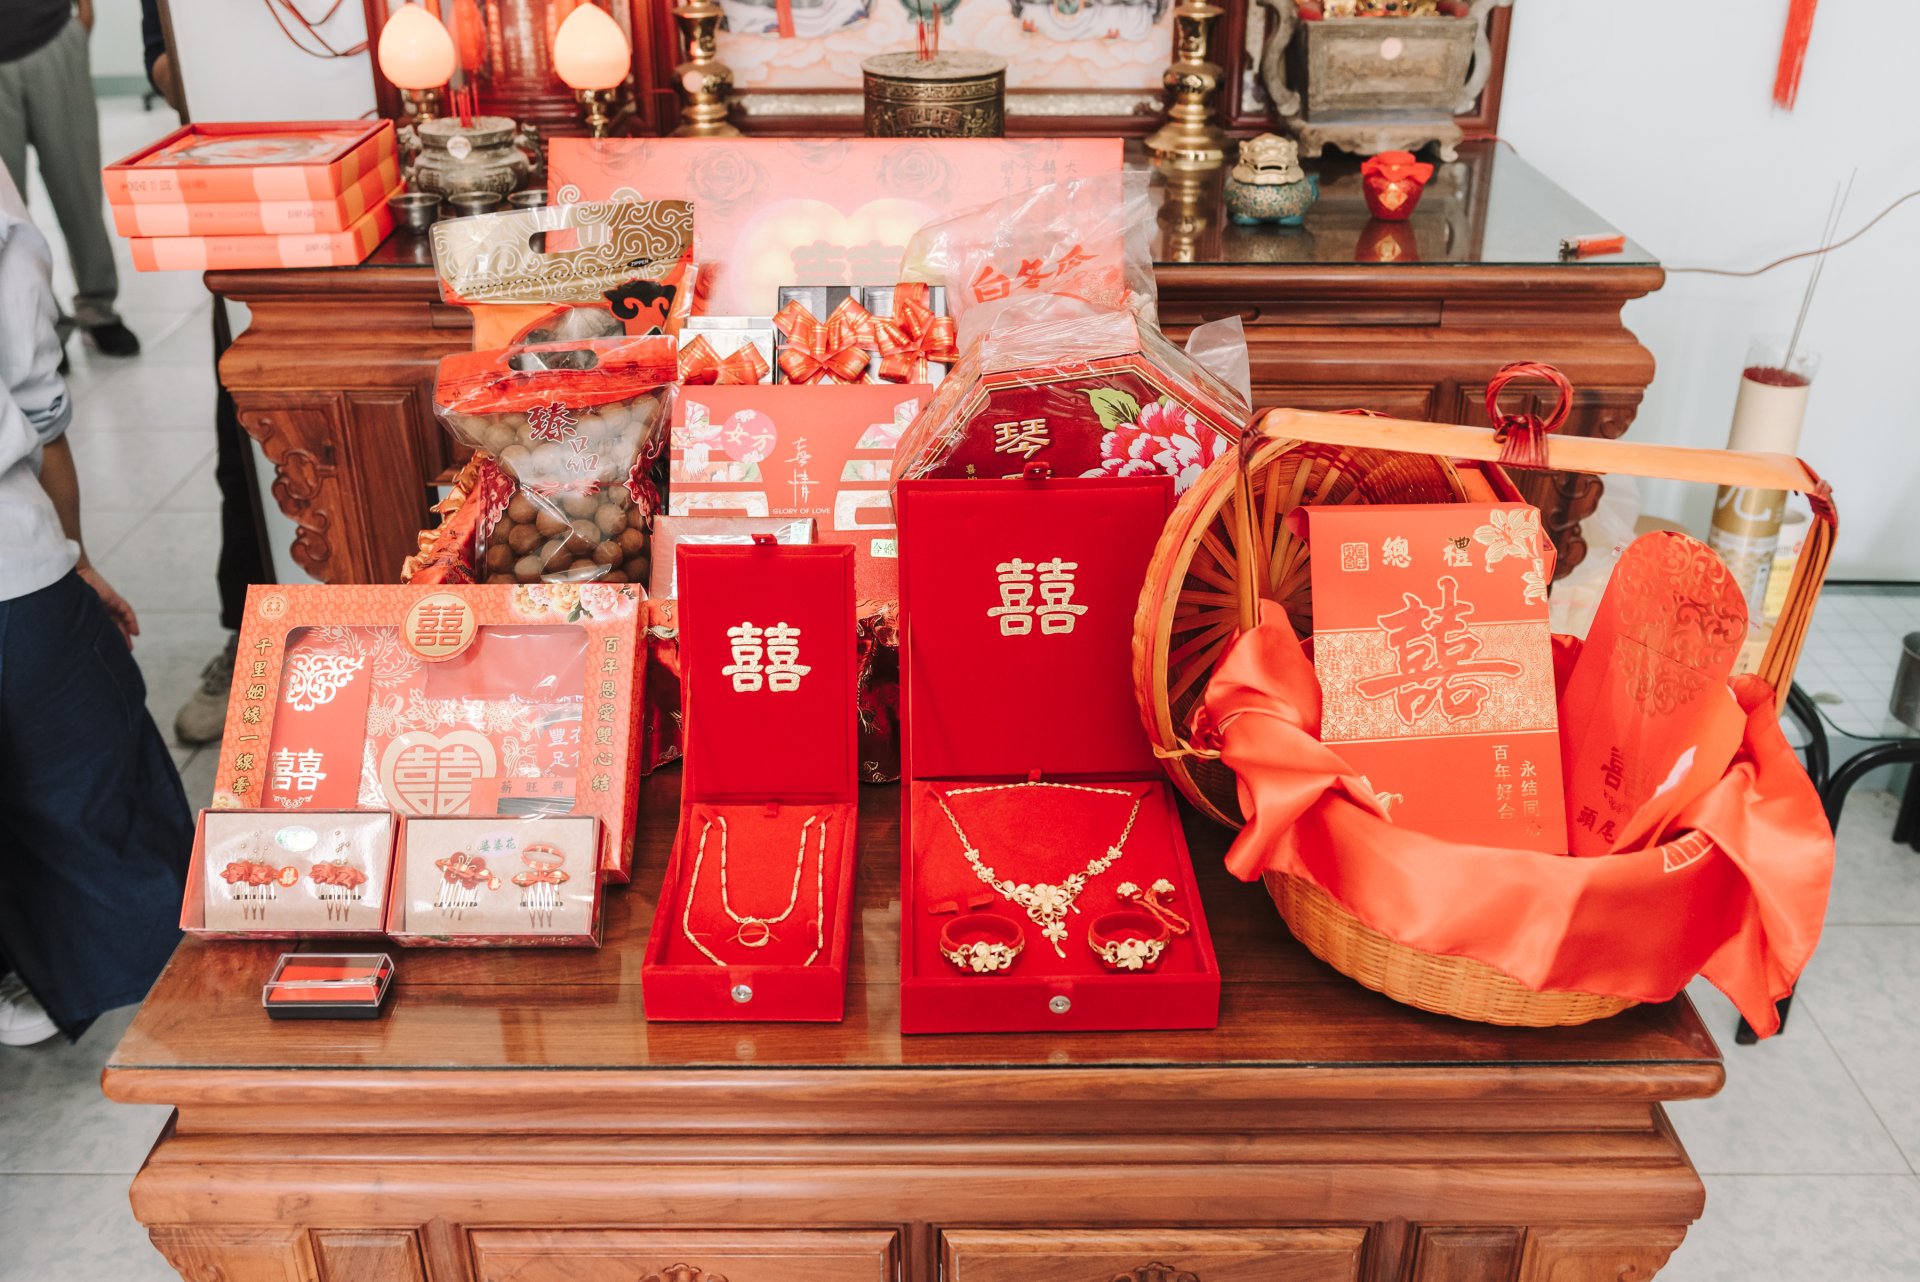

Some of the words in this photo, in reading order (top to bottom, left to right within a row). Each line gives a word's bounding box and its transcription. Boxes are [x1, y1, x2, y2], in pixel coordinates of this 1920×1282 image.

[724, 423, 774, 450] 女方
[994, 418, 1050, 459] 琴
[772, 507, 798, 515] GLORY
[799, 507, 810, 515] OF
[812, 506, 831, 515] LOVE
[987, 557, 1089, 637] 囍
[415, 603, 465, 647] 囍
[722, 621, 811, 693] 囍
[1492, 744, 1515, 820] 百年好合
